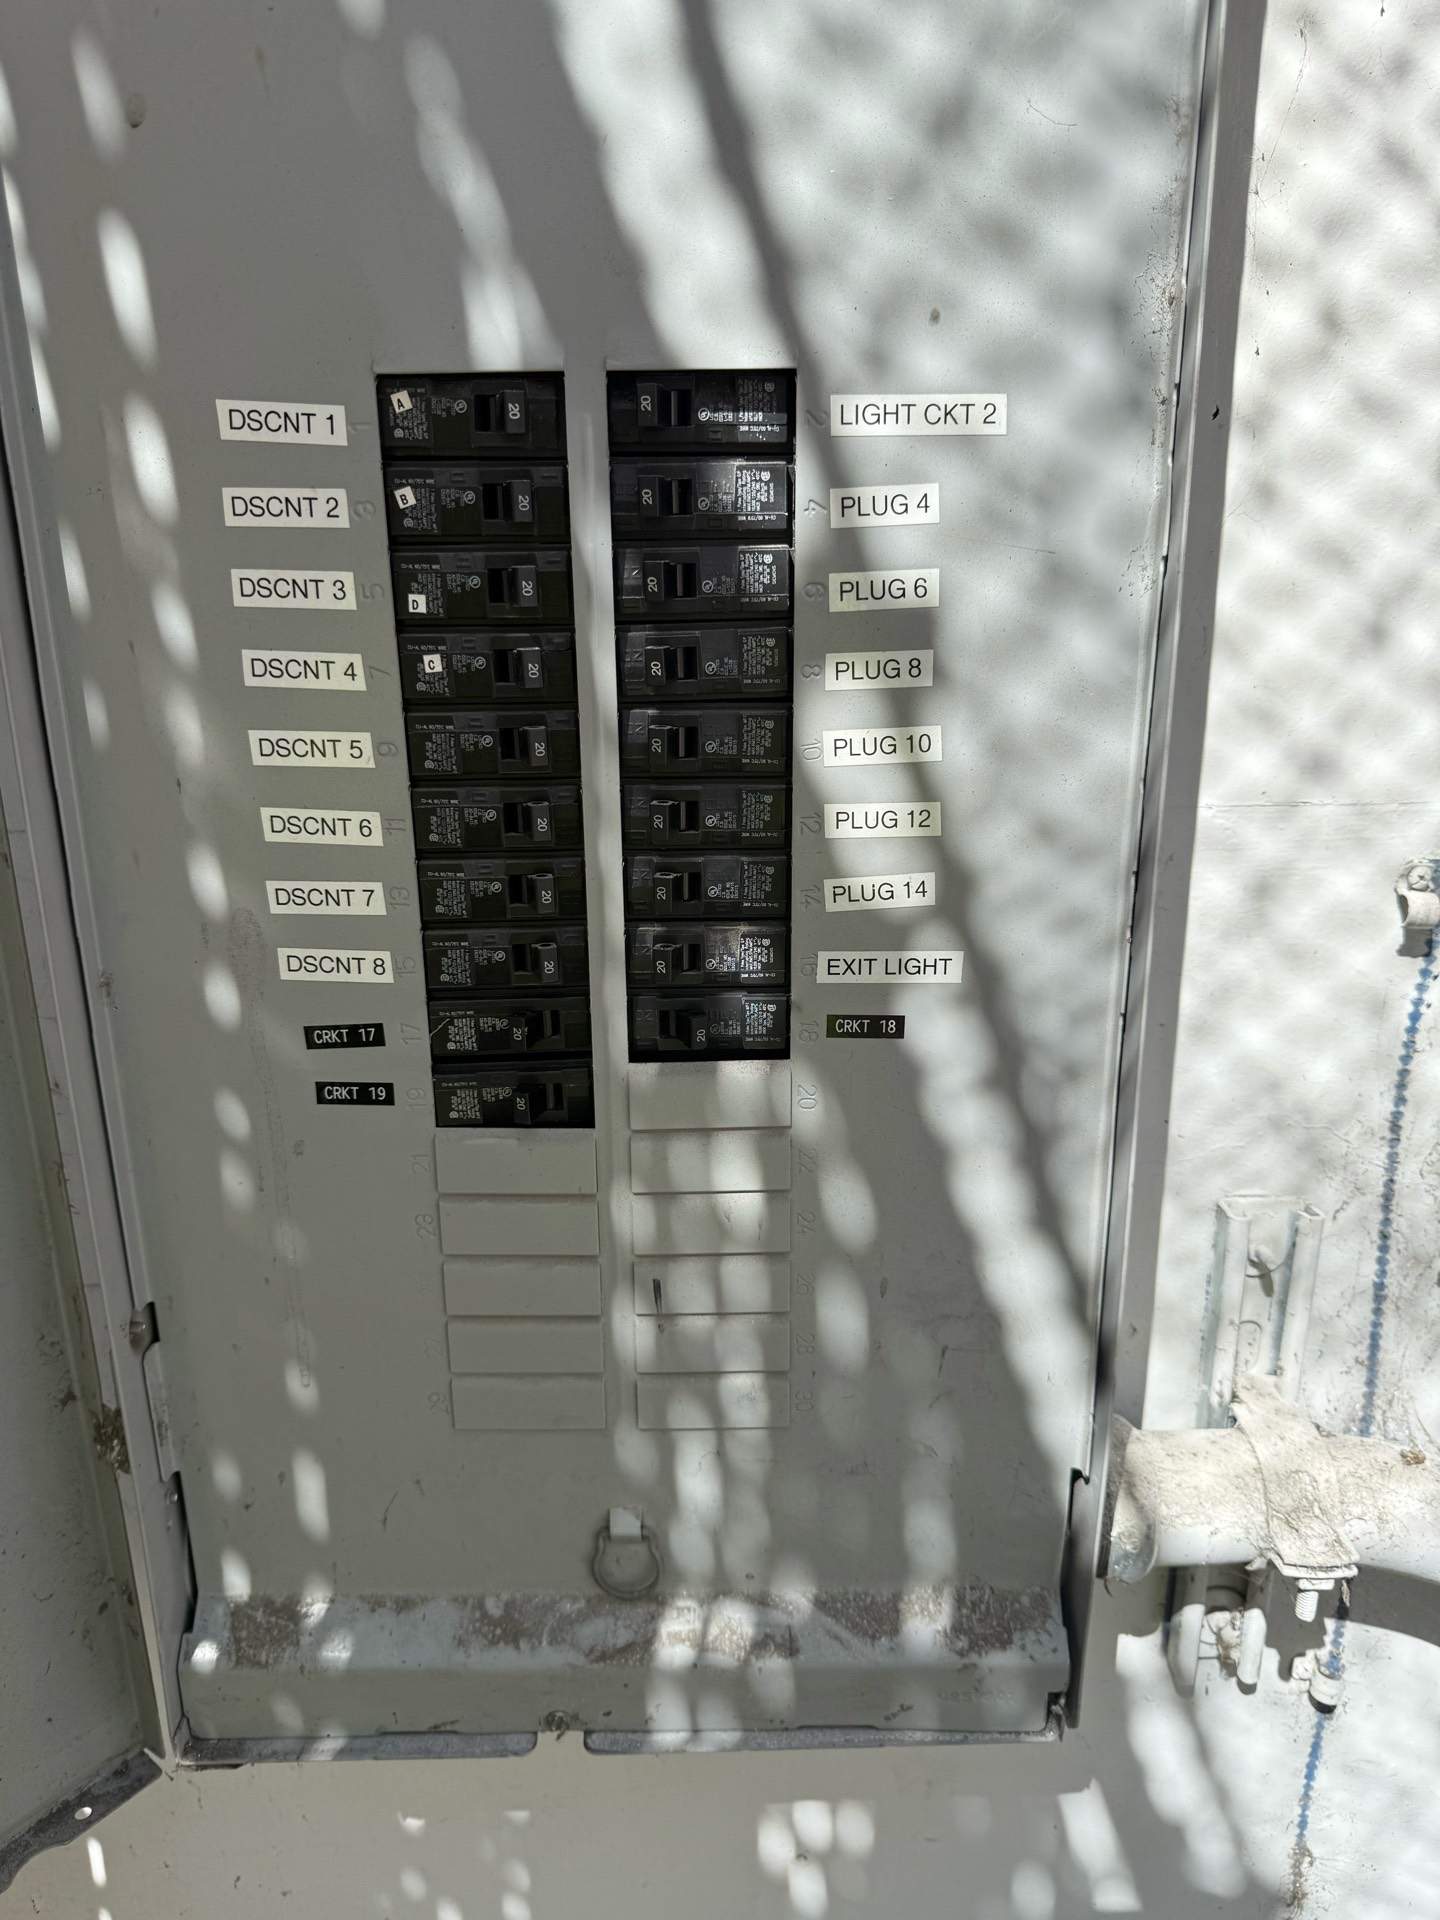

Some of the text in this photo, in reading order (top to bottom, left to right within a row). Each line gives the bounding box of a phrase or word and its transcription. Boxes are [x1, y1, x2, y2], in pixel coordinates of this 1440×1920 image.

[397, 399, 405, 410] A
[508, 403, 520, 419] 20
[641, 396, 651, 411] 20
[841, 403, 996, 425] LIGHT CKT 2
[229, 409, 334, 435] DSCNT 1
[400, 494, 408, 505] B
[519, 495, 529, 510] 20
[642, 489, 652, 504] 20
[232, 496, 339, 518] DSCNT 2
[804, 499, 826, 516] 4
[841, 493, 929, 518] PLUG 4
[240, 578, 346, 600] DSCNT 3
[361, 584, 384, 599] 5
[522, 581, 533, 596] 20
[648, 577, 657, 592] 20
[840, 578, 927, 601] PLUG 6
[412, 600, 418, 610] D
[251, 658, 357, 681] DSCNT 4
[428, 660, 435, 670] C
[529, 664, 539, 677] 20
[651, 662, 661, 675] 20
[801, 664, 822, 679] 8
[836, 658, 921, 680] PLUG 8
[259, 738, 362, 759] DSCNT 5
[535, 743, 545, 756] 20
[652, 738, 661, 752] 20
[800, 739, 823, 760] 10
[834, 734, 931, 756] PLUG 10
[270, 815, 372, 837] DSCNT 6
[538, 818, 547, 831] 20
[654, 815, 663, 828] 20
[836, 809, 930, 829] PLUG 12
[275, 888, 374, 906] DSCNT 7
[542, 891, 551, 903] 20
[657, 887, 665, 900] 20
[833, 881, 927, 903] PLUG 14
[287, 955, 385, 975] DSCNT 8
[545, 961, 554, 973] 20
[657, 961, 665, 973] 20
[828, 958, 952, 975] EXIT LIGHT
[836, 1019, 895, 1033] CRKT 18
[314, 1028, 374, 1043] CRKT 17
[514, 1028, 522, 1040] 20
[697, 1030, 705, 1041] 20
[325, 1086, 385, 1100] CRKT 19
[798, 1084, 816, 1110] 20
[517, 1098, 525, 1110] 20
